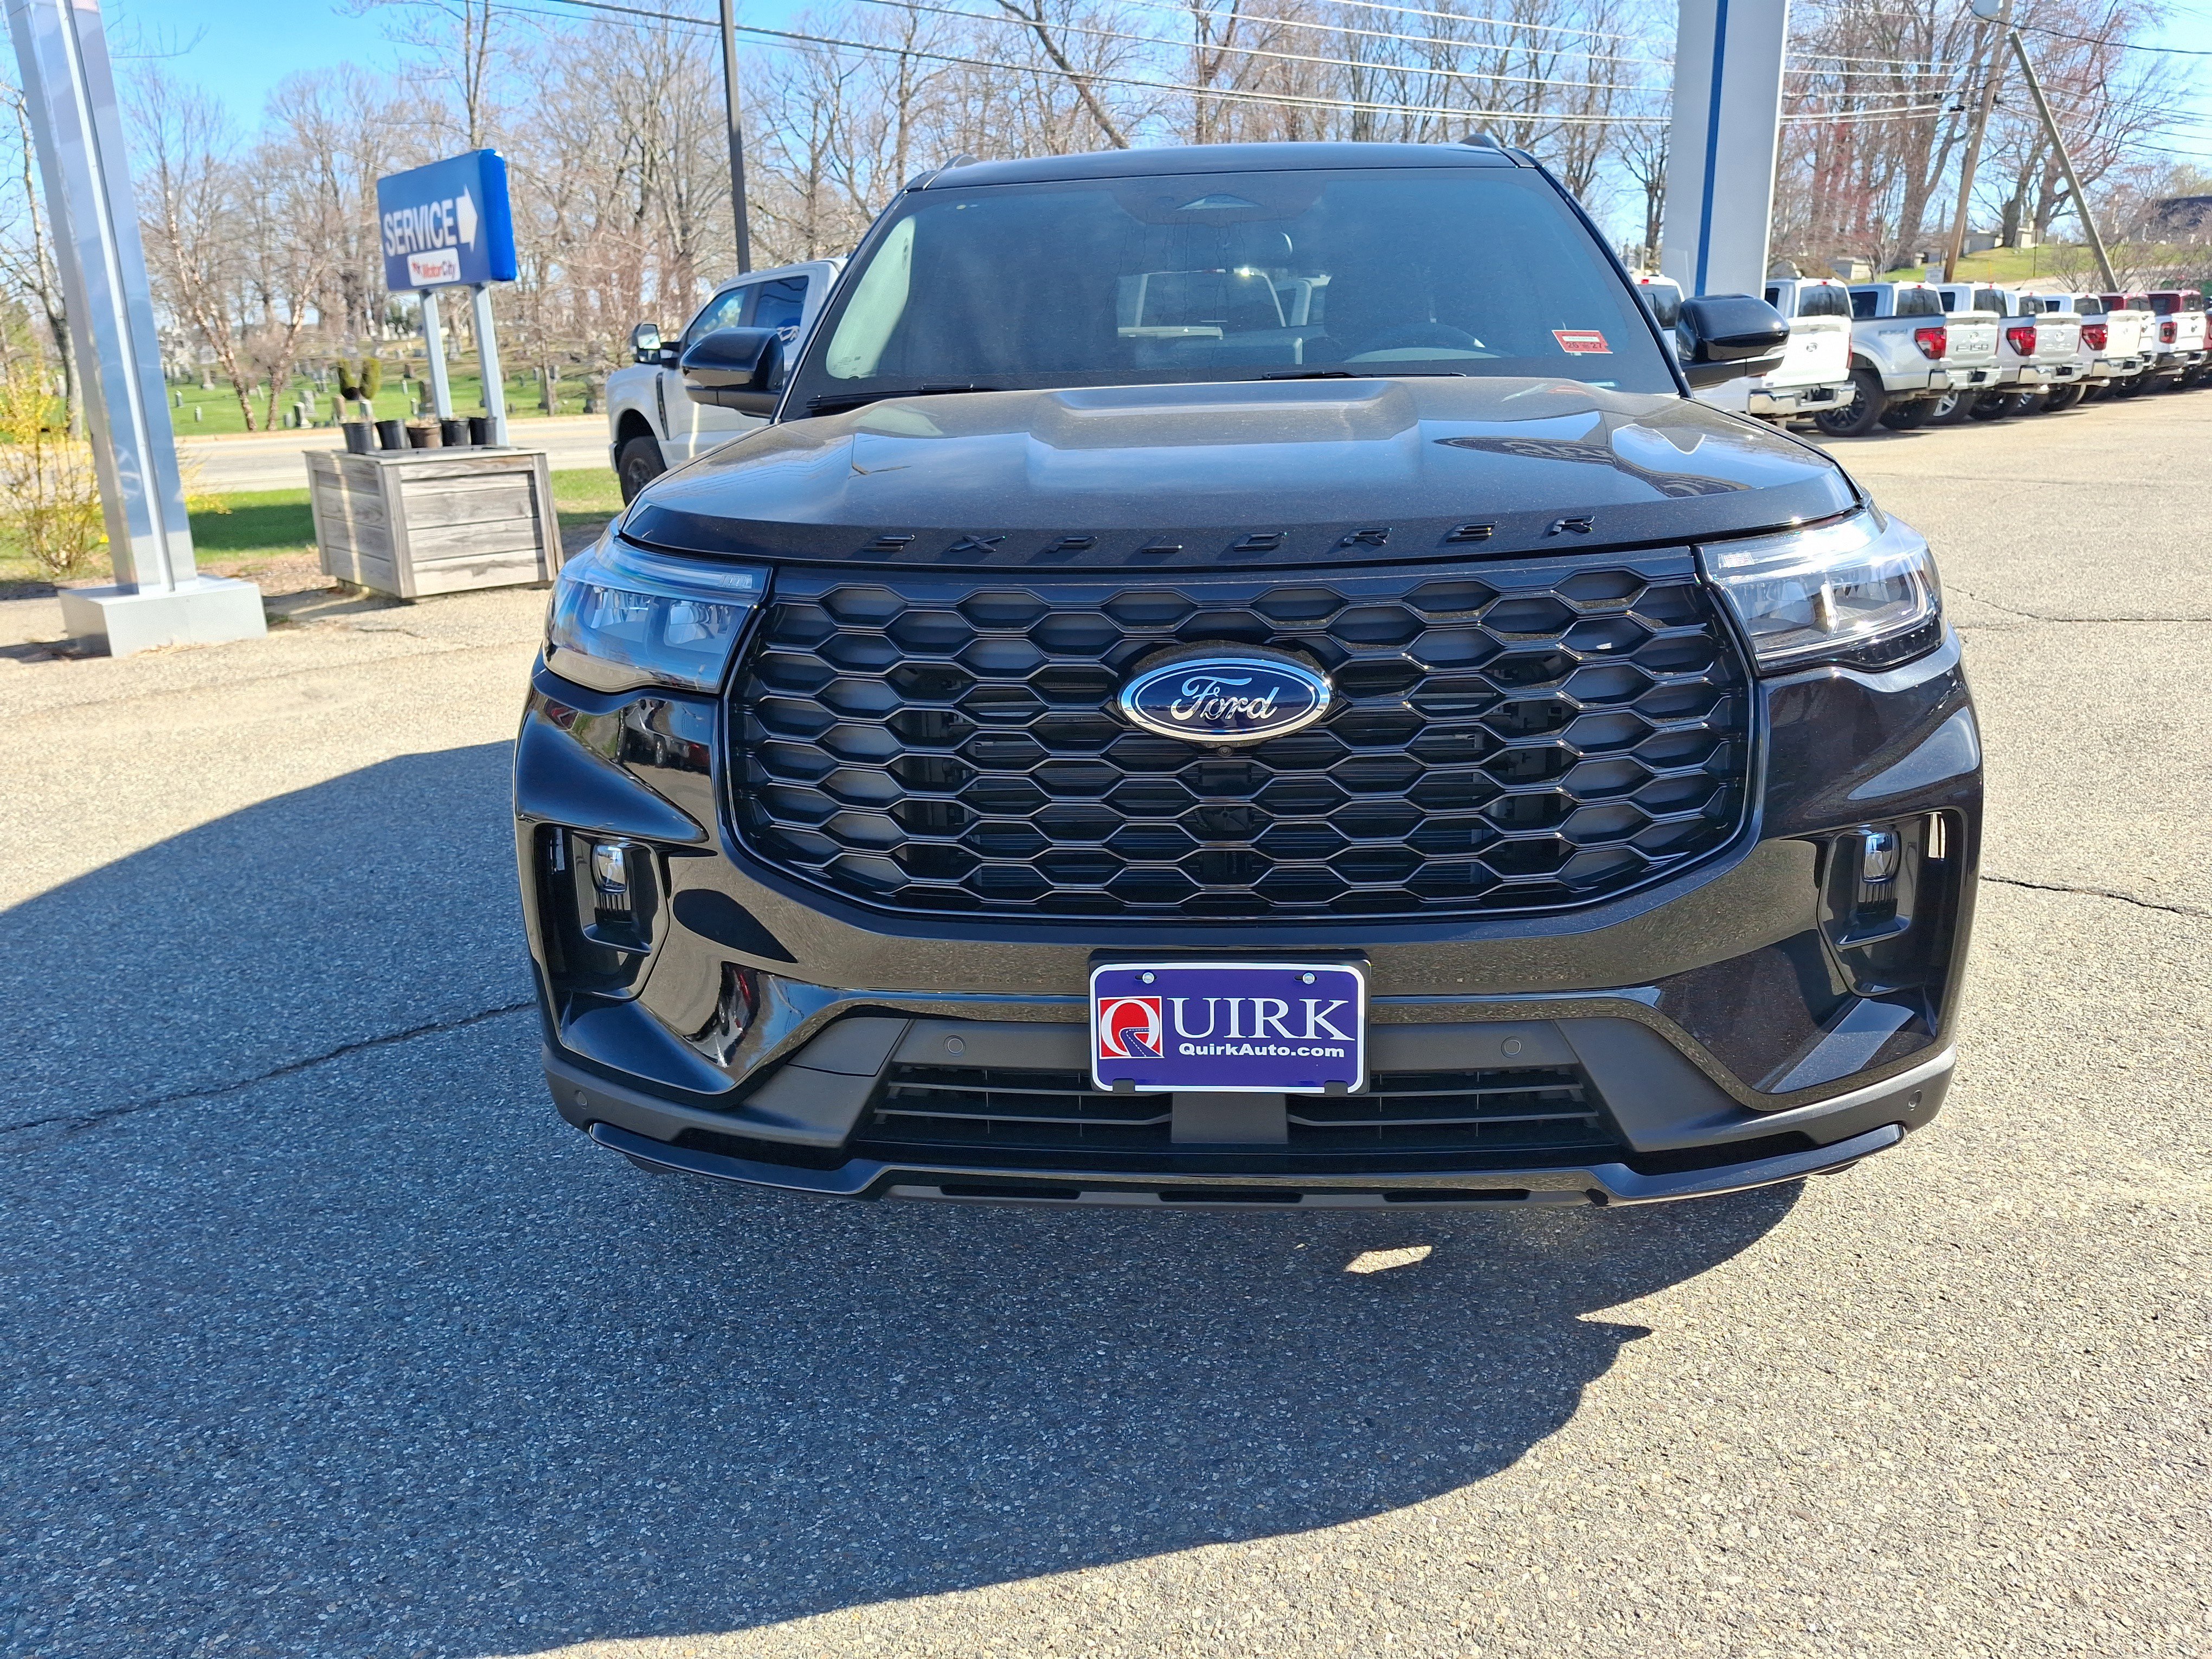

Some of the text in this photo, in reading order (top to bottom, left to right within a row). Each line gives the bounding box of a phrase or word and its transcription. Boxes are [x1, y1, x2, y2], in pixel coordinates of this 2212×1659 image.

[383, 198, 457, 257] SERVICE
[863, 515, 1596, 552] EXPLORER
[1171, 676, 1279, 721] Ford
[1100, 998, 1355, 1058] QUIRK
[1179, 1042, 1345, 1057] QuirkAuto.com
